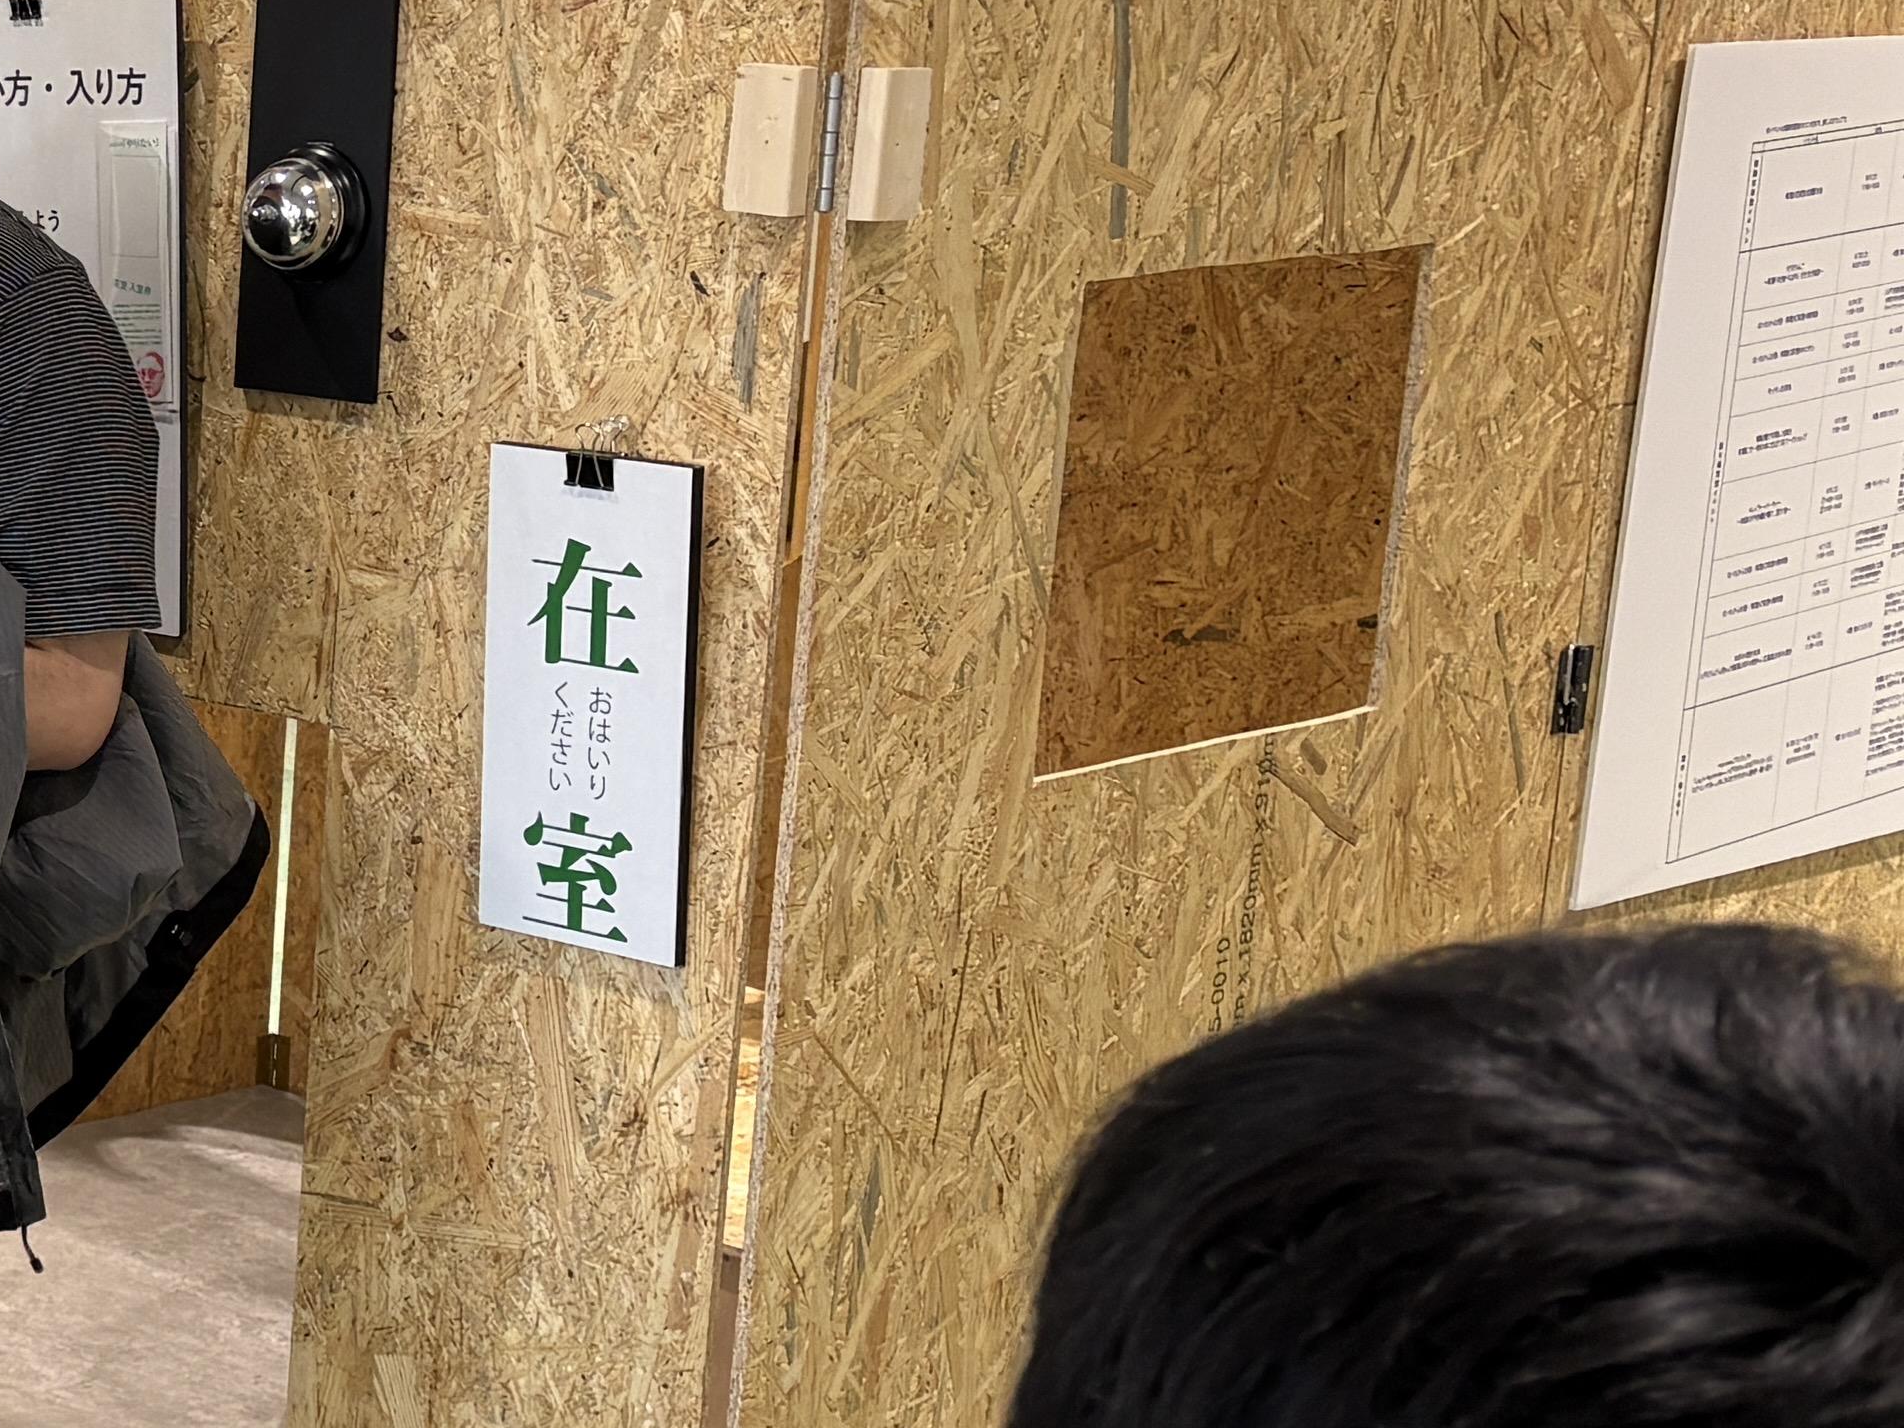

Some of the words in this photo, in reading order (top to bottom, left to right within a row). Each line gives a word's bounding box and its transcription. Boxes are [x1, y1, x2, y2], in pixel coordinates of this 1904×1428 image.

[548, 680, 573, 792] ください
[588, 685, 613, 801] おはいり
